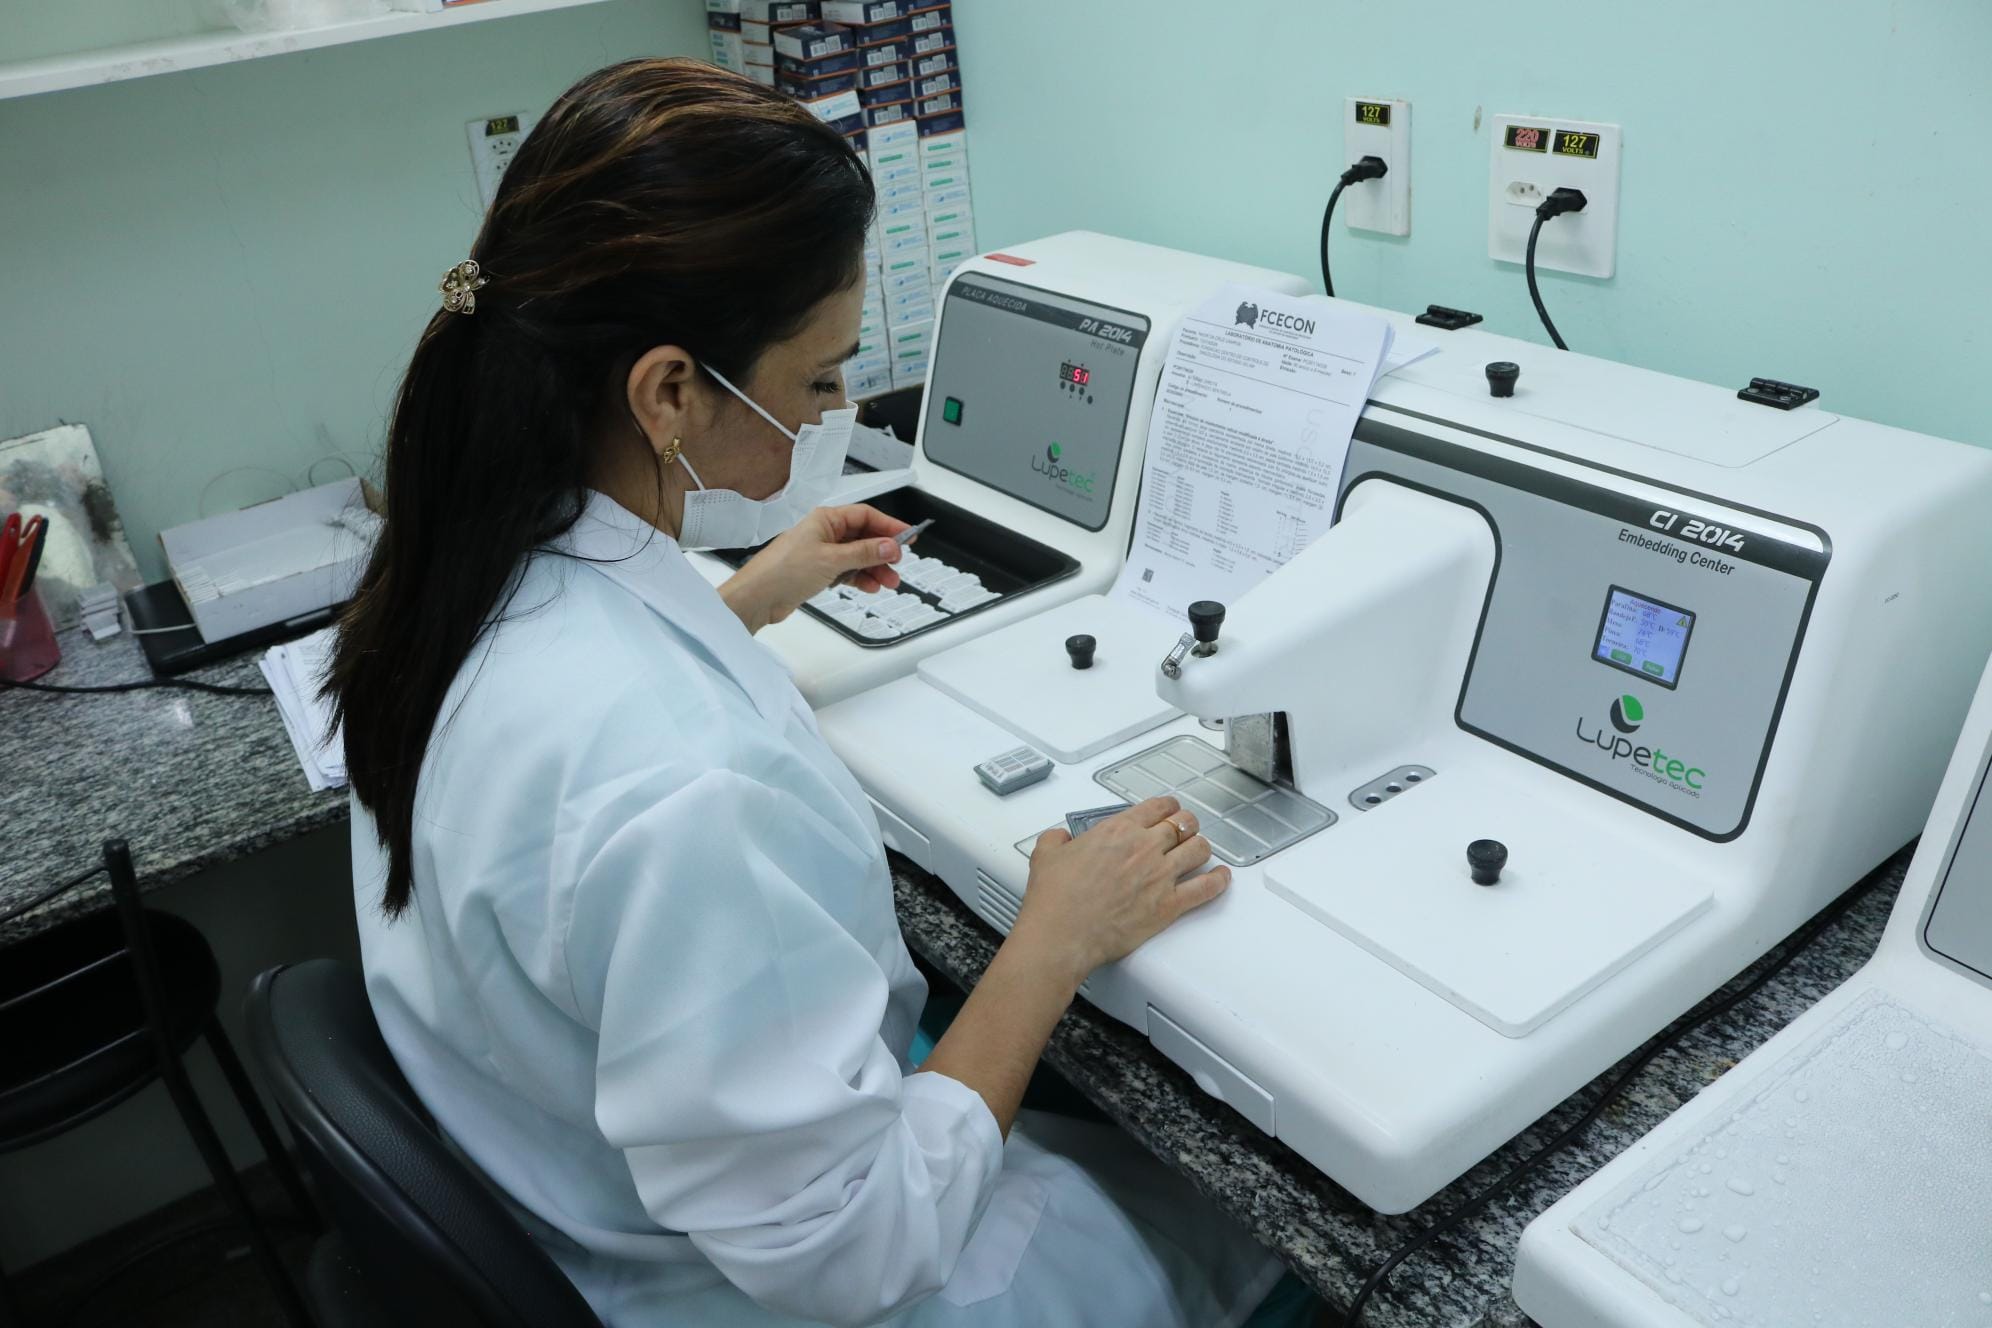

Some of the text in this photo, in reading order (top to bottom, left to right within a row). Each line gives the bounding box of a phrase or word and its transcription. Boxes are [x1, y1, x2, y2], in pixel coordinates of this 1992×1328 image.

[1362, 106, 1380, 118] 127
[1515, 128, 1539, 142] 220
[1563, 134, 1588, 149] 127
[1562, 146, 1584, 155] VOLTS
[1079, 318, 1133, 343] PA 2014
[1260, 309, 1316, 335] FCECON
[1090, 339, 1125, 356] Hot Plate
[1031, 454, 1095, 494] Lupetec
[1649, 509, 1745, 553] CI 2014
[1617, 528, 1736, 577] Embedding Center
[1576, 716, 1706, 791] Lupetec
[1630, 763, 1668, 785] Tecnologia
